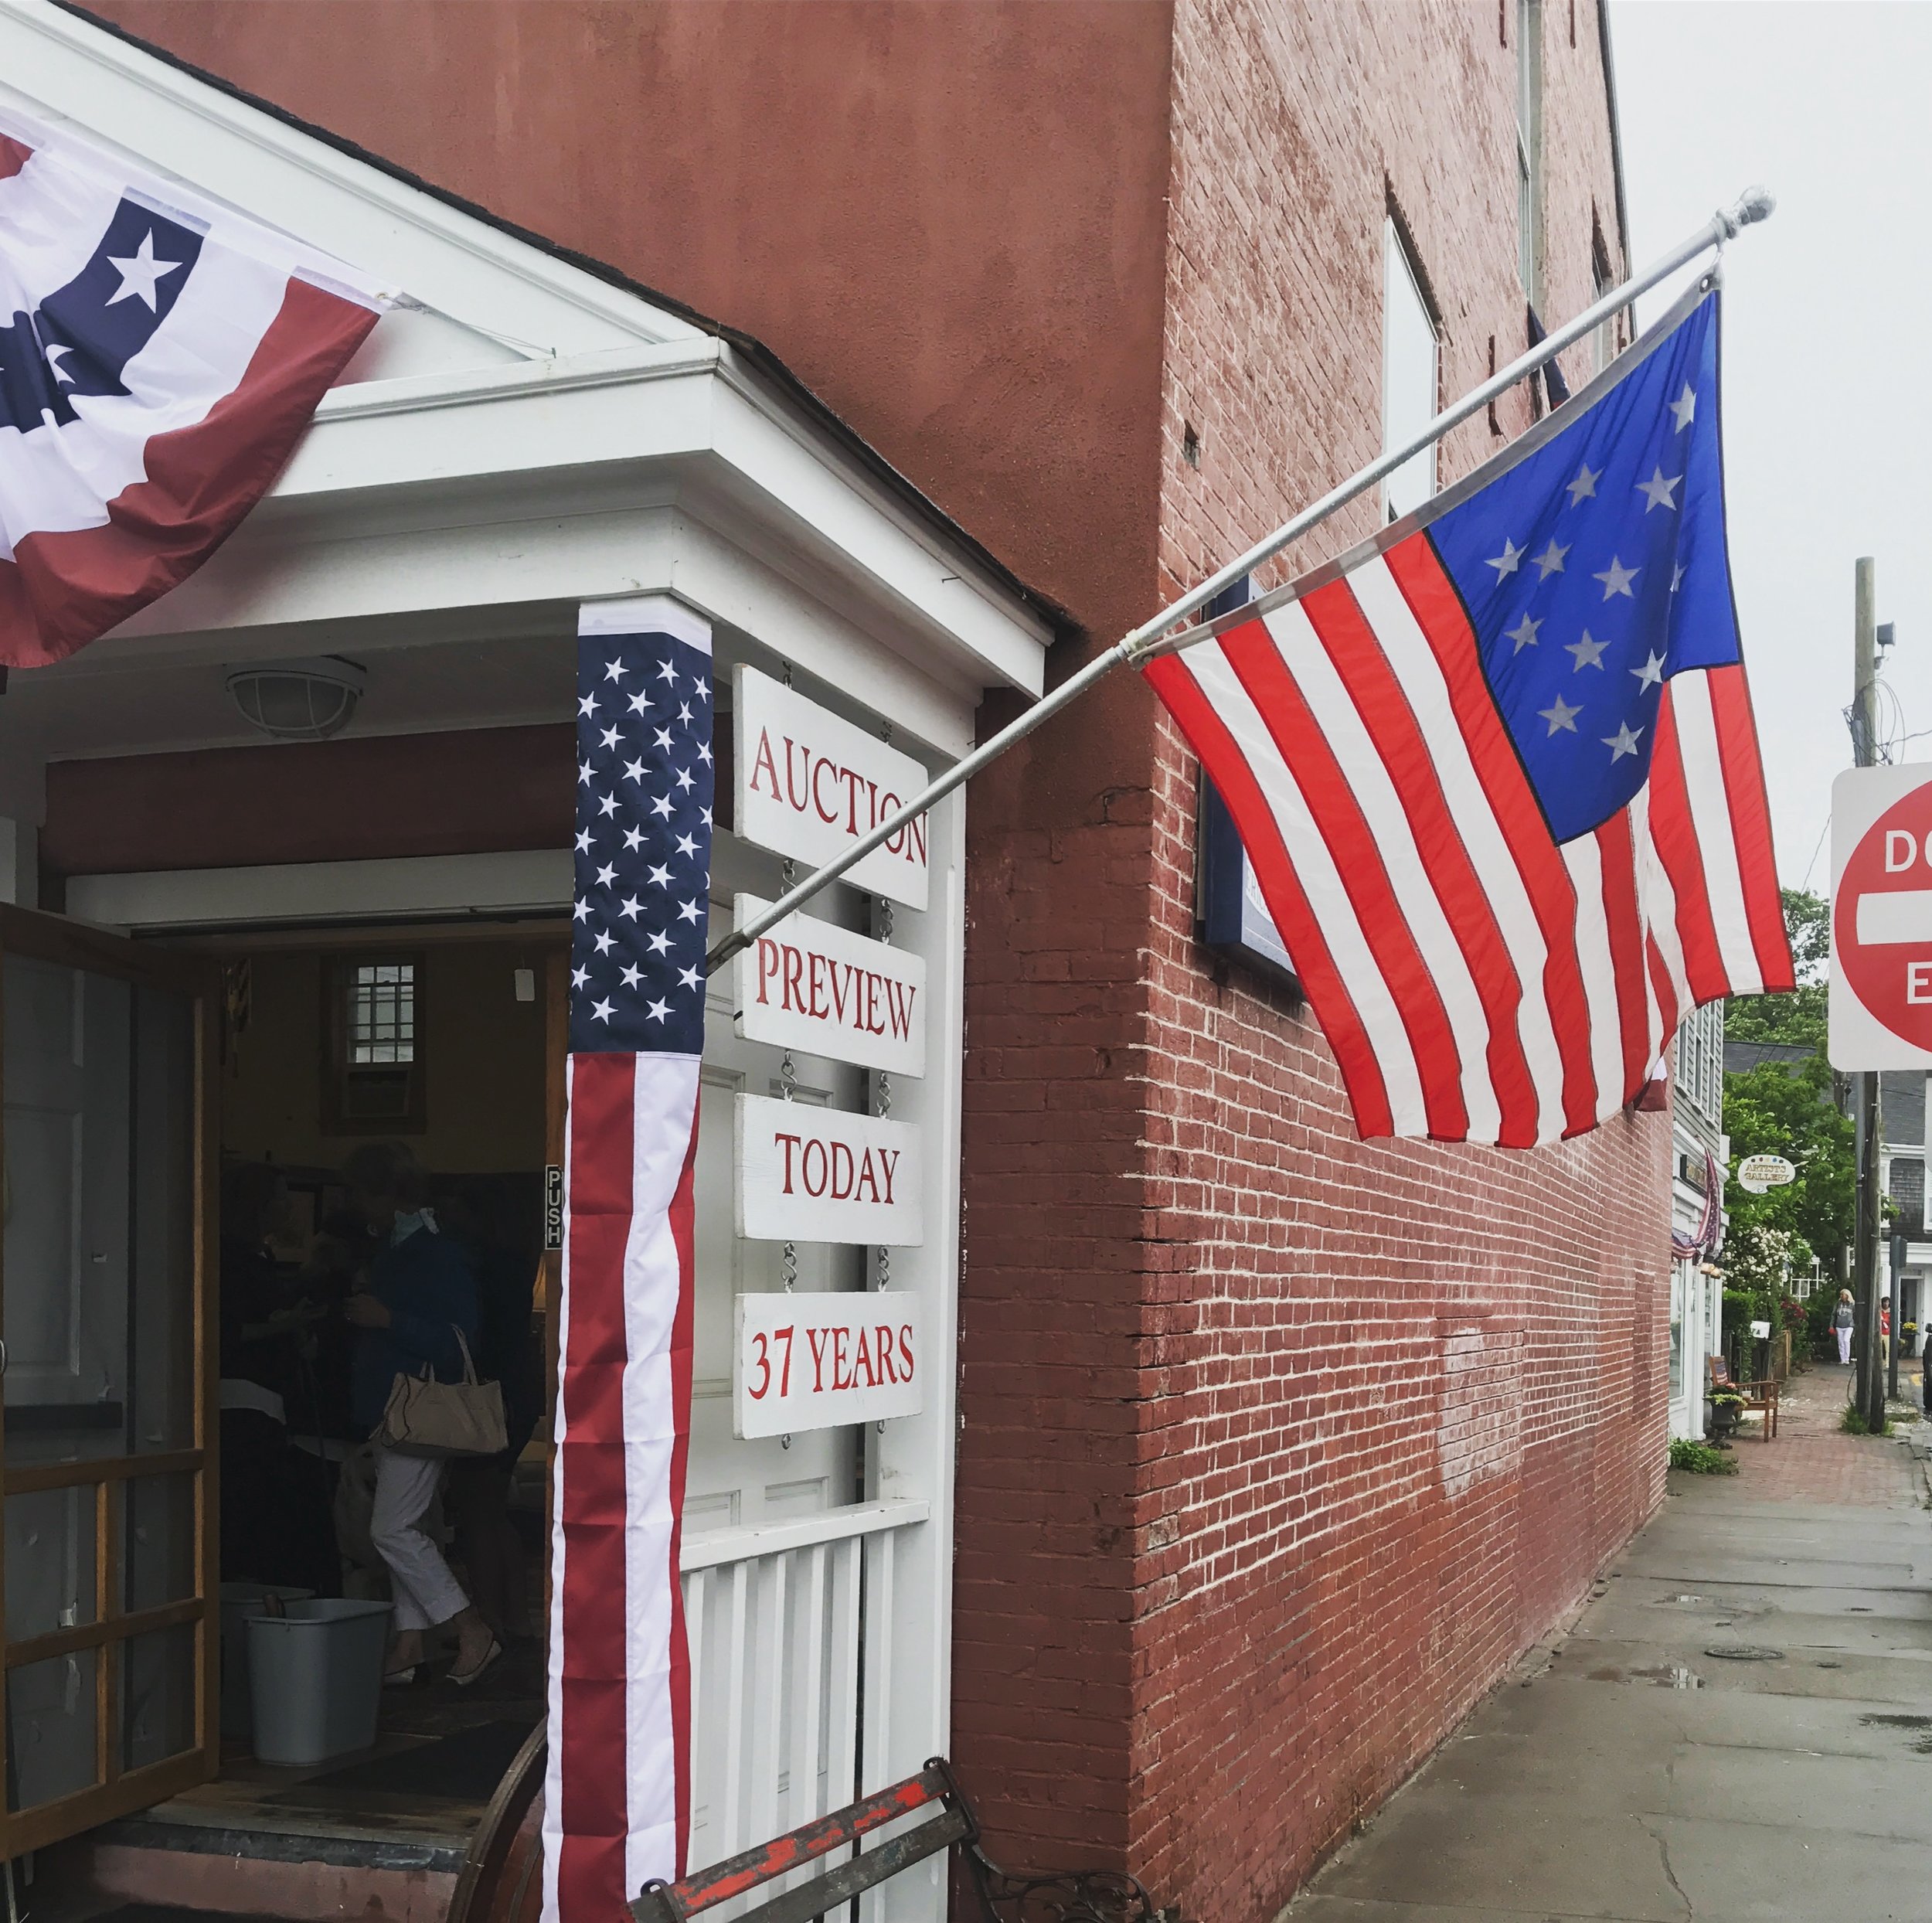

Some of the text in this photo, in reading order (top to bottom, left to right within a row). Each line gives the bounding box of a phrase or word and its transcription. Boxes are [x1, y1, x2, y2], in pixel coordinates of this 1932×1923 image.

[750, 725, 927, 868] AUCTION
[756, 937, 917, 1043] PREVIEW
[775, 1132, 901, 1205] TODAY
[1744, 1173, 1790, 1182] GALLERY
[548, 1170, 561, 1244] PUSH
[748, 1324, 915, 1401] 37 YEARS
